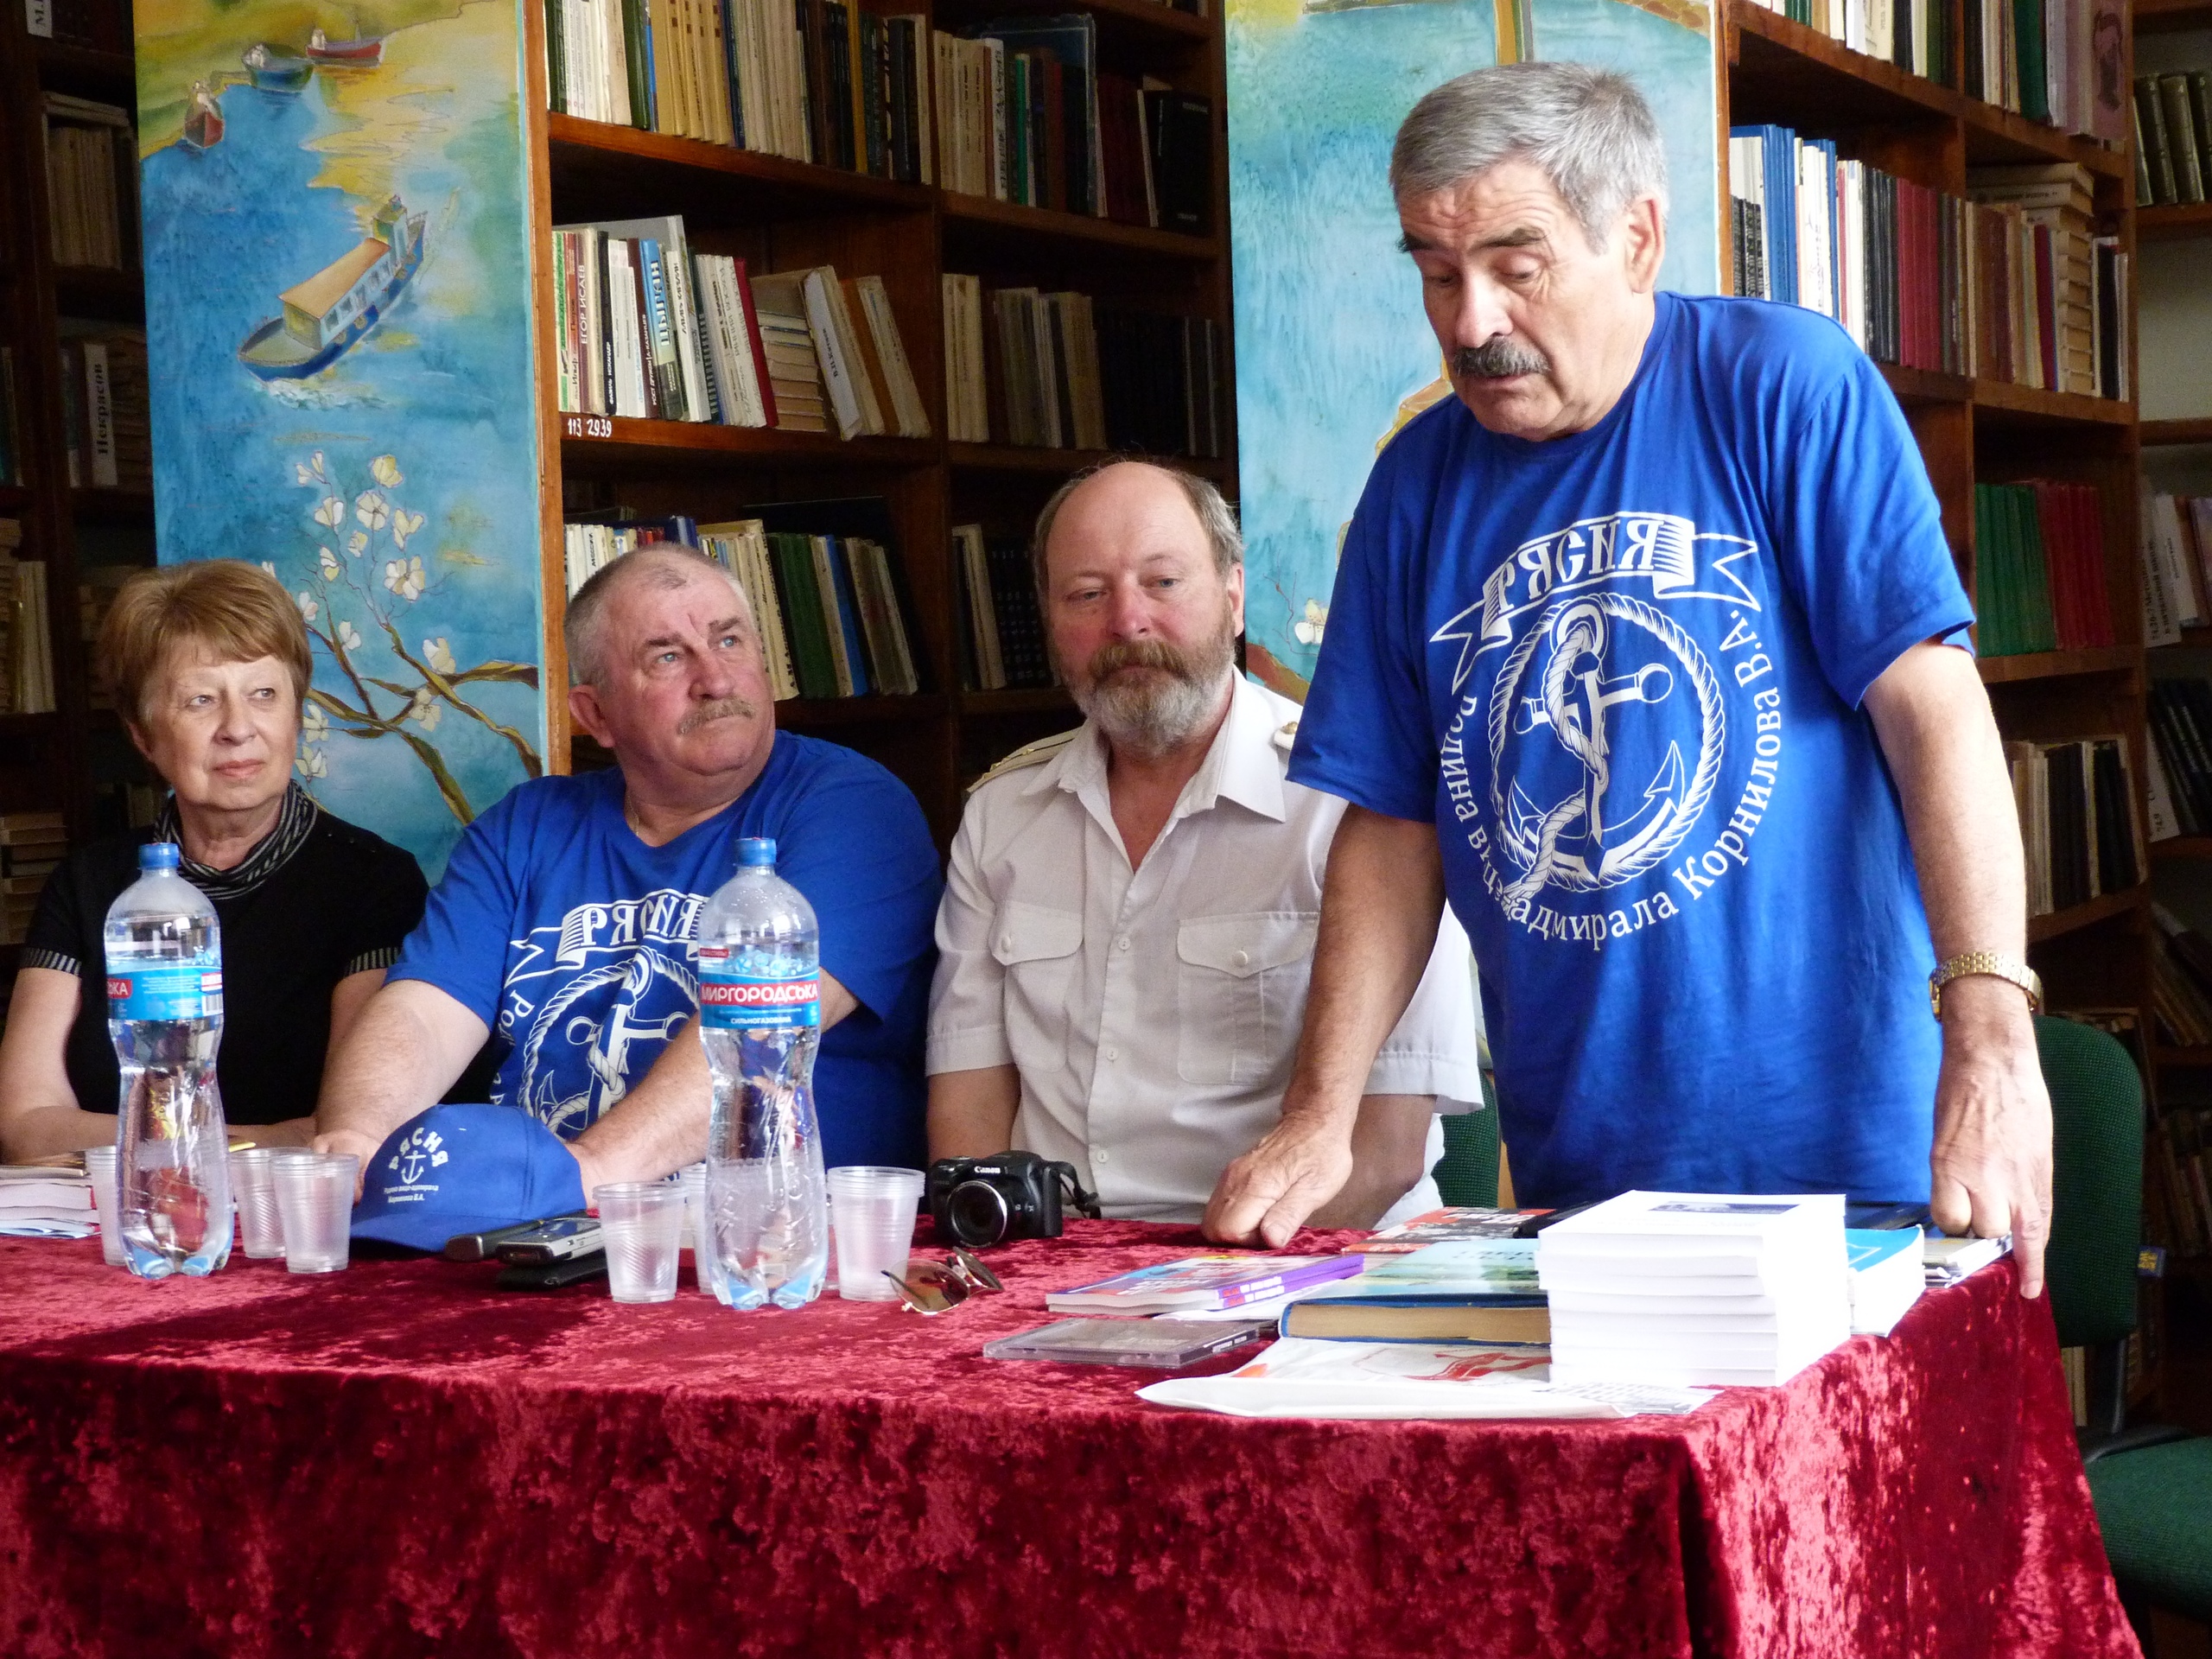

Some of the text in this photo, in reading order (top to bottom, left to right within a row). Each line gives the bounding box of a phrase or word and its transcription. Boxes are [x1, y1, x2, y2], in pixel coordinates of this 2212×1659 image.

[578, 265, 587, 308] ИСАЕВ
[651, 260, 671, 346] ЦЫГАН
[94, 364, 109, 454] Некрасов
[568, 417, 612, 437] 113 2939
[1673, 688, 1782, 900] Корнилова
[701, 983, 818, 1003] МИРГОРОДСЬКА
